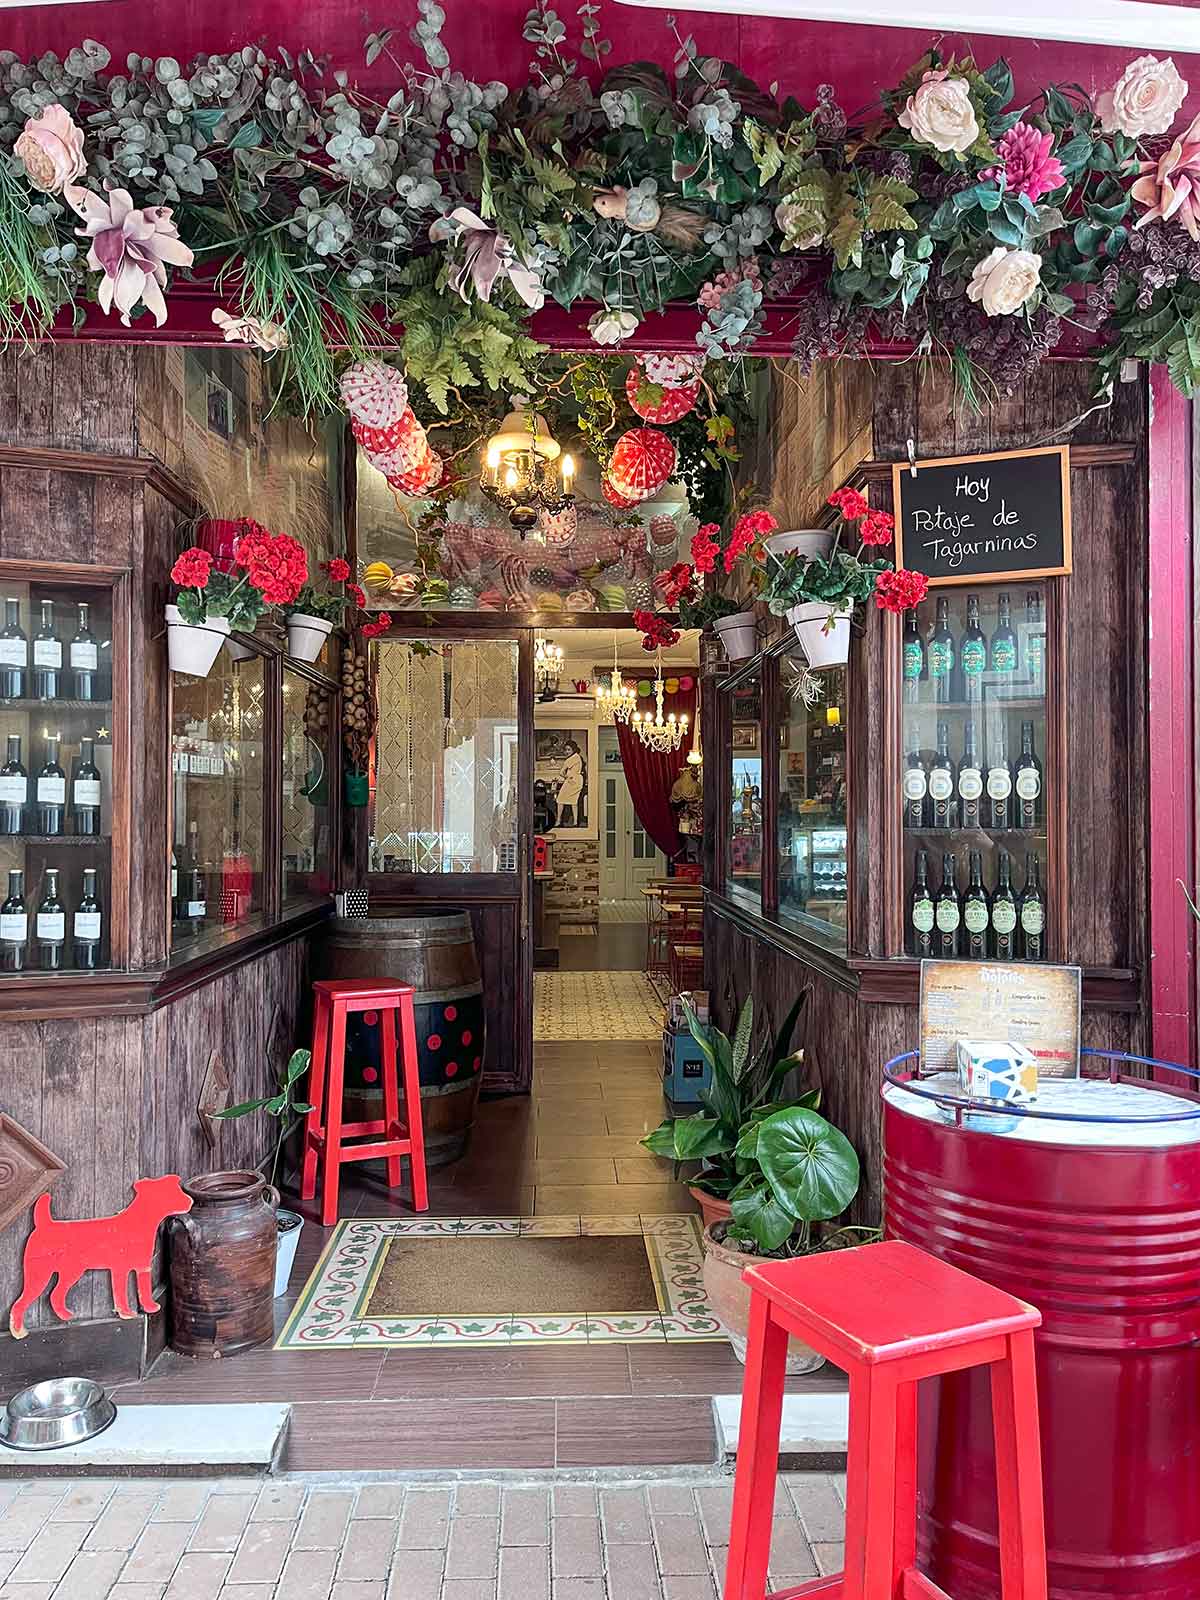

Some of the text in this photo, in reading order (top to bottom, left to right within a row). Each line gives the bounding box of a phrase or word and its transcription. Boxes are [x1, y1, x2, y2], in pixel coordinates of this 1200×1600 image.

[955, 475, 990, 503] Hoy
[911, 499, 1019, 537] Potaje de
[922, 533, 1038, 567] Tagarninas
